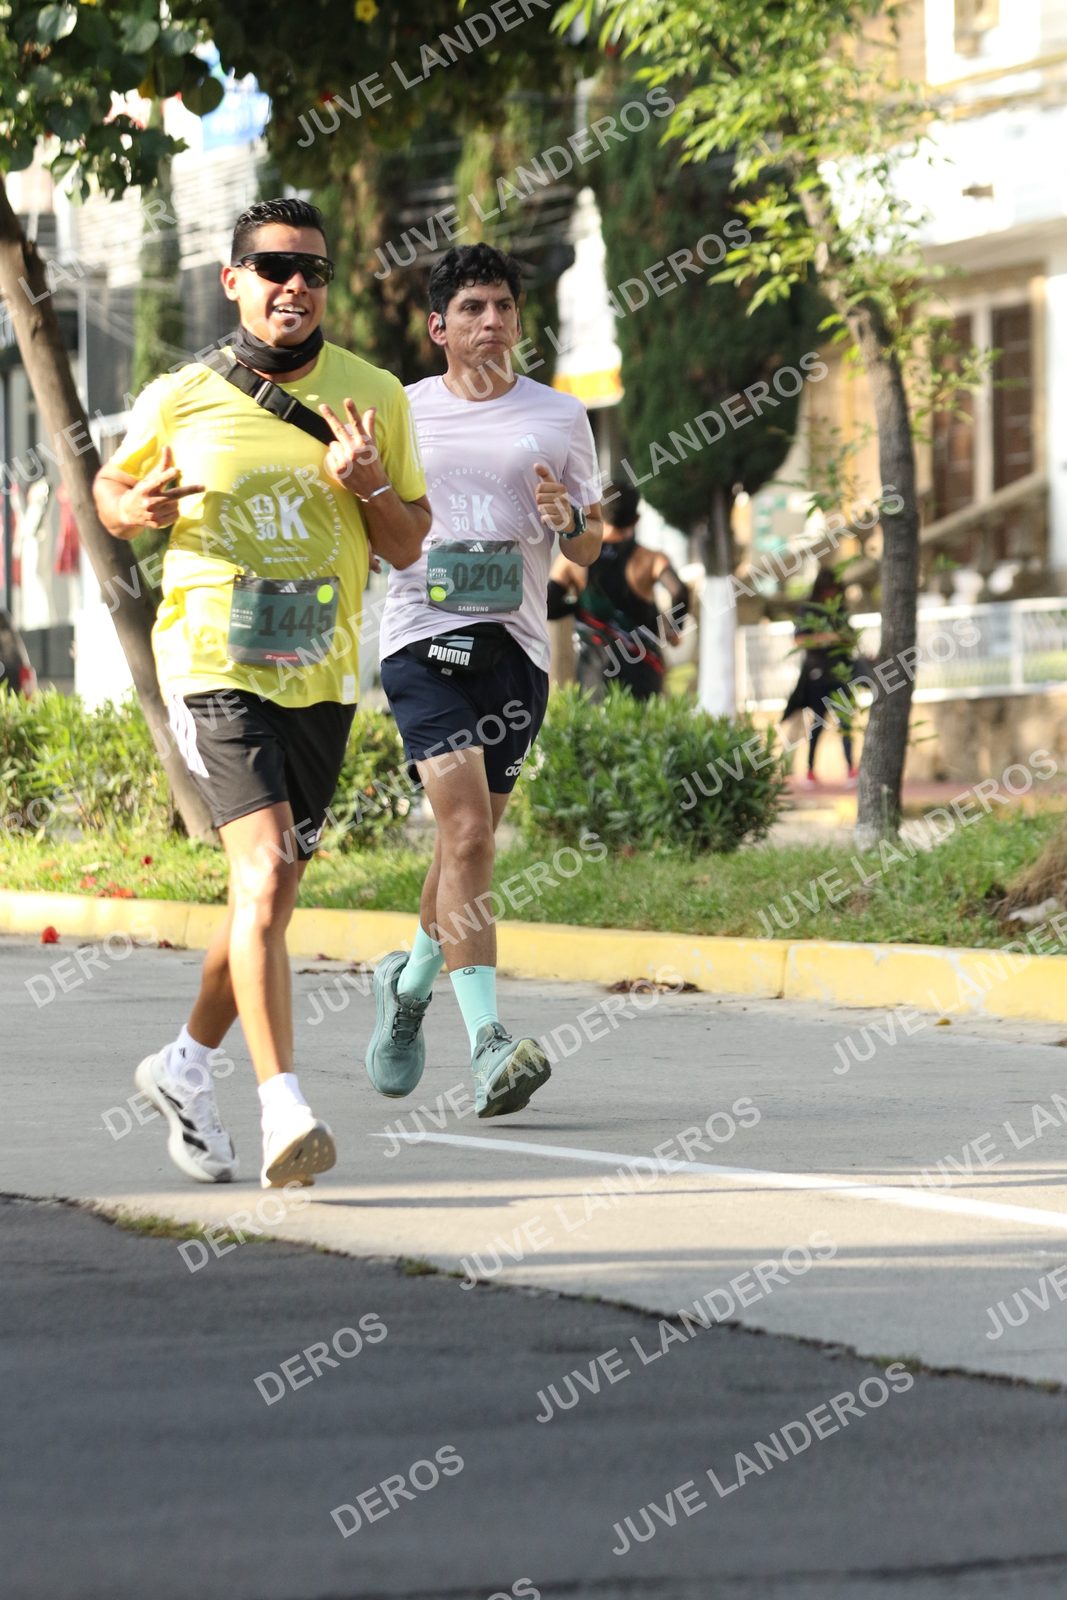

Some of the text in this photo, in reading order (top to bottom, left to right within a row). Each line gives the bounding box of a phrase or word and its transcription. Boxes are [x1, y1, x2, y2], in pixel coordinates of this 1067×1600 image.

[449, 493, 468, 510] 15
[472, 494, 498, 532] K
[279, 495, 310, 540] K
[452, 516, 470, 532] 30
[256, 522, 278, 541] 30
[452, 562, 520, 592] 0204
[258, 605, 333, 637] 1445
[427, 644, 471, 666] PUMA
